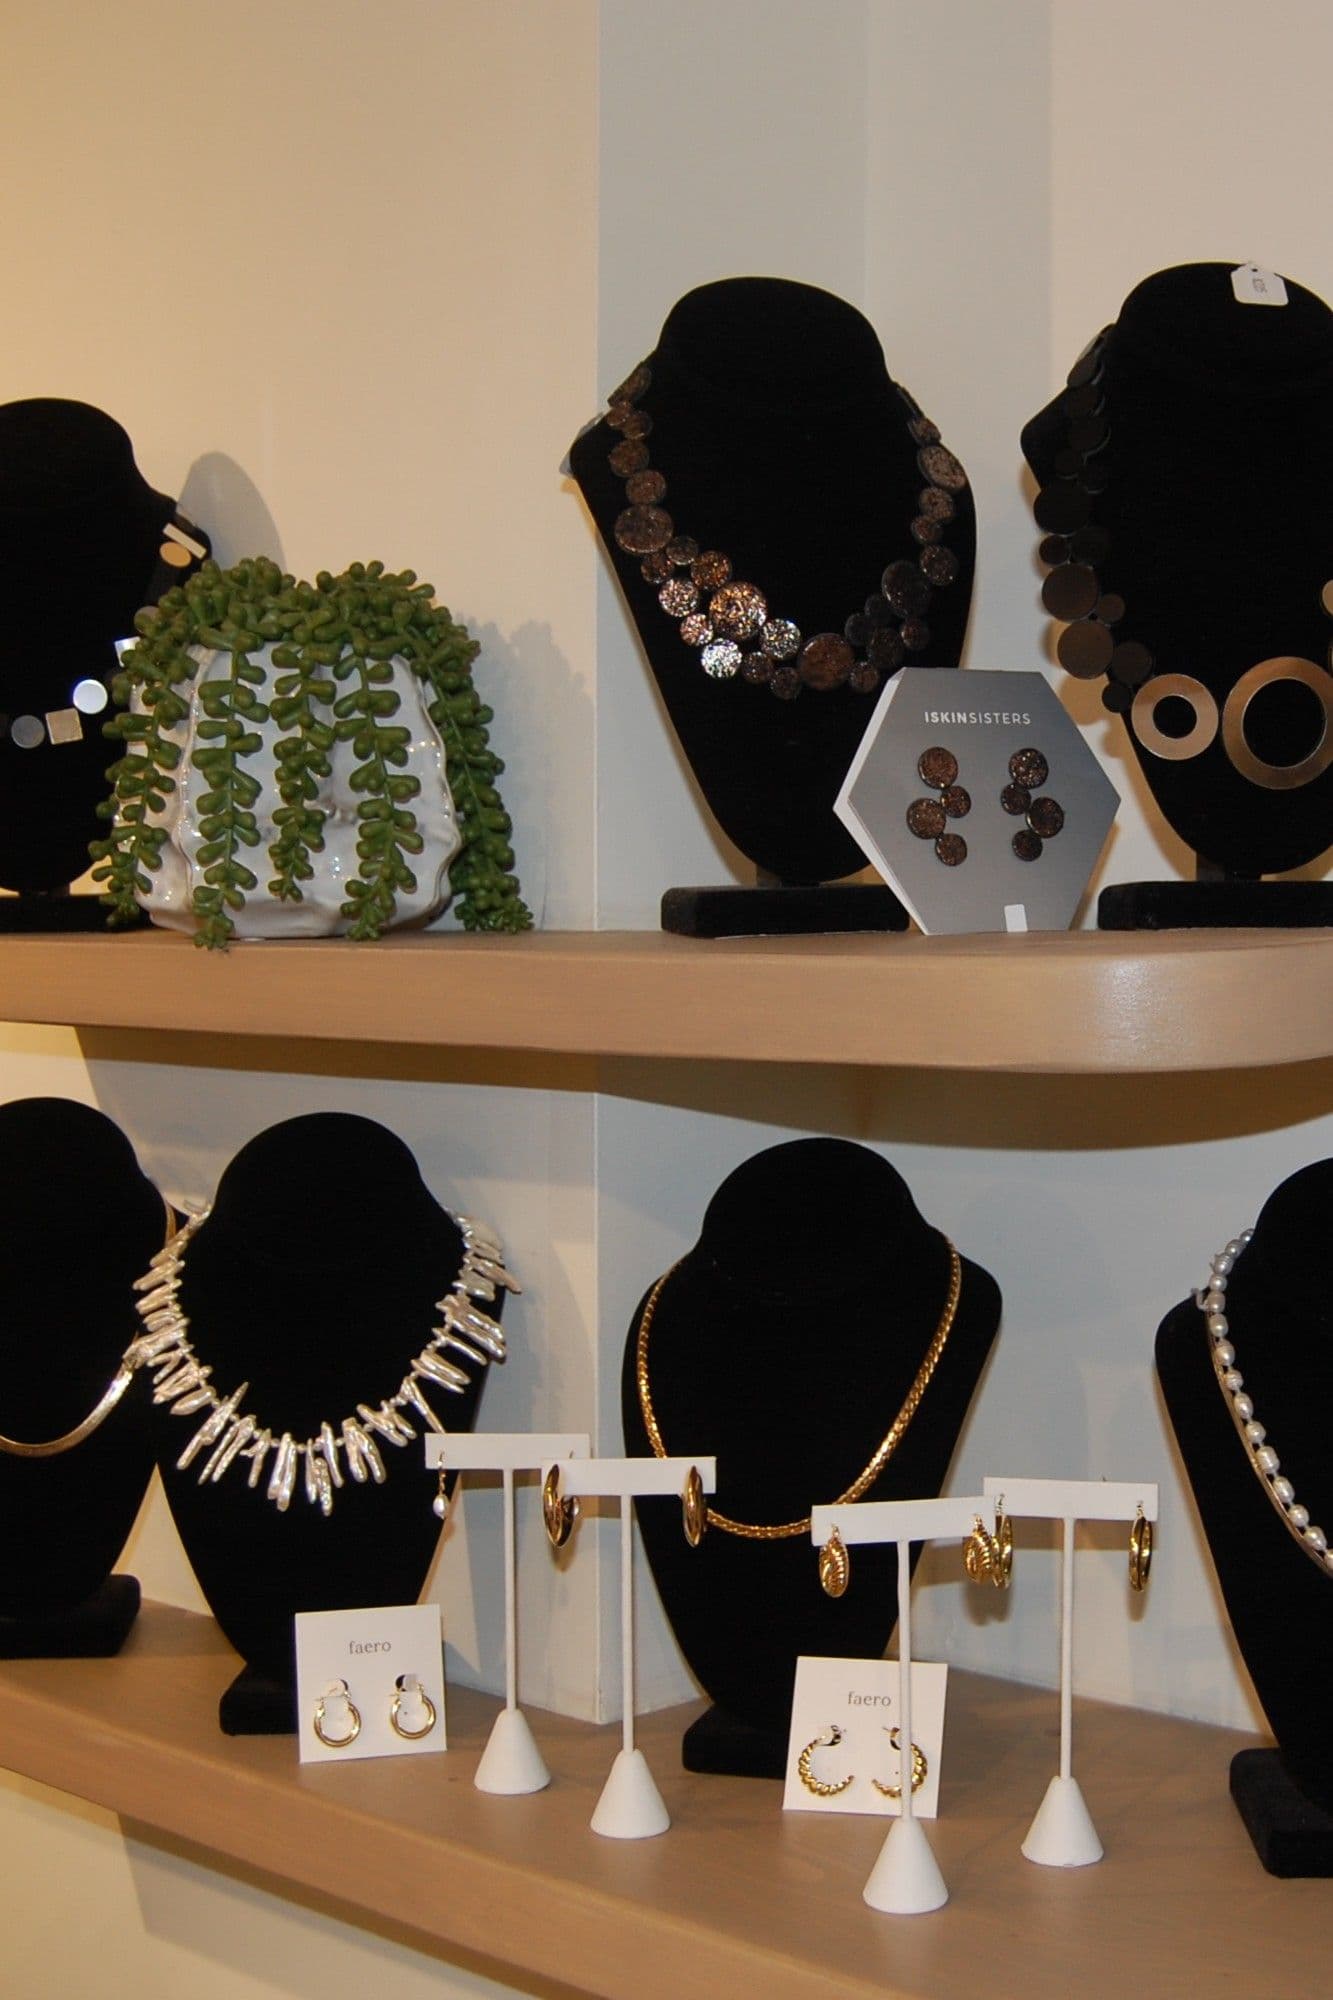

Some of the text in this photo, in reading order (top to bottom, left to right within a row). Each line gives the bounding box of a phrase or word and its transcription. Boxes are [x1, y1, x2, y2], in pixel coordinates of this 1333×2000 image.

[924, 711, 1031, 725] ISKINSISTERS
[349, 1640, 392, 1655] faero
[847, 1690, 892, 1707] faero
